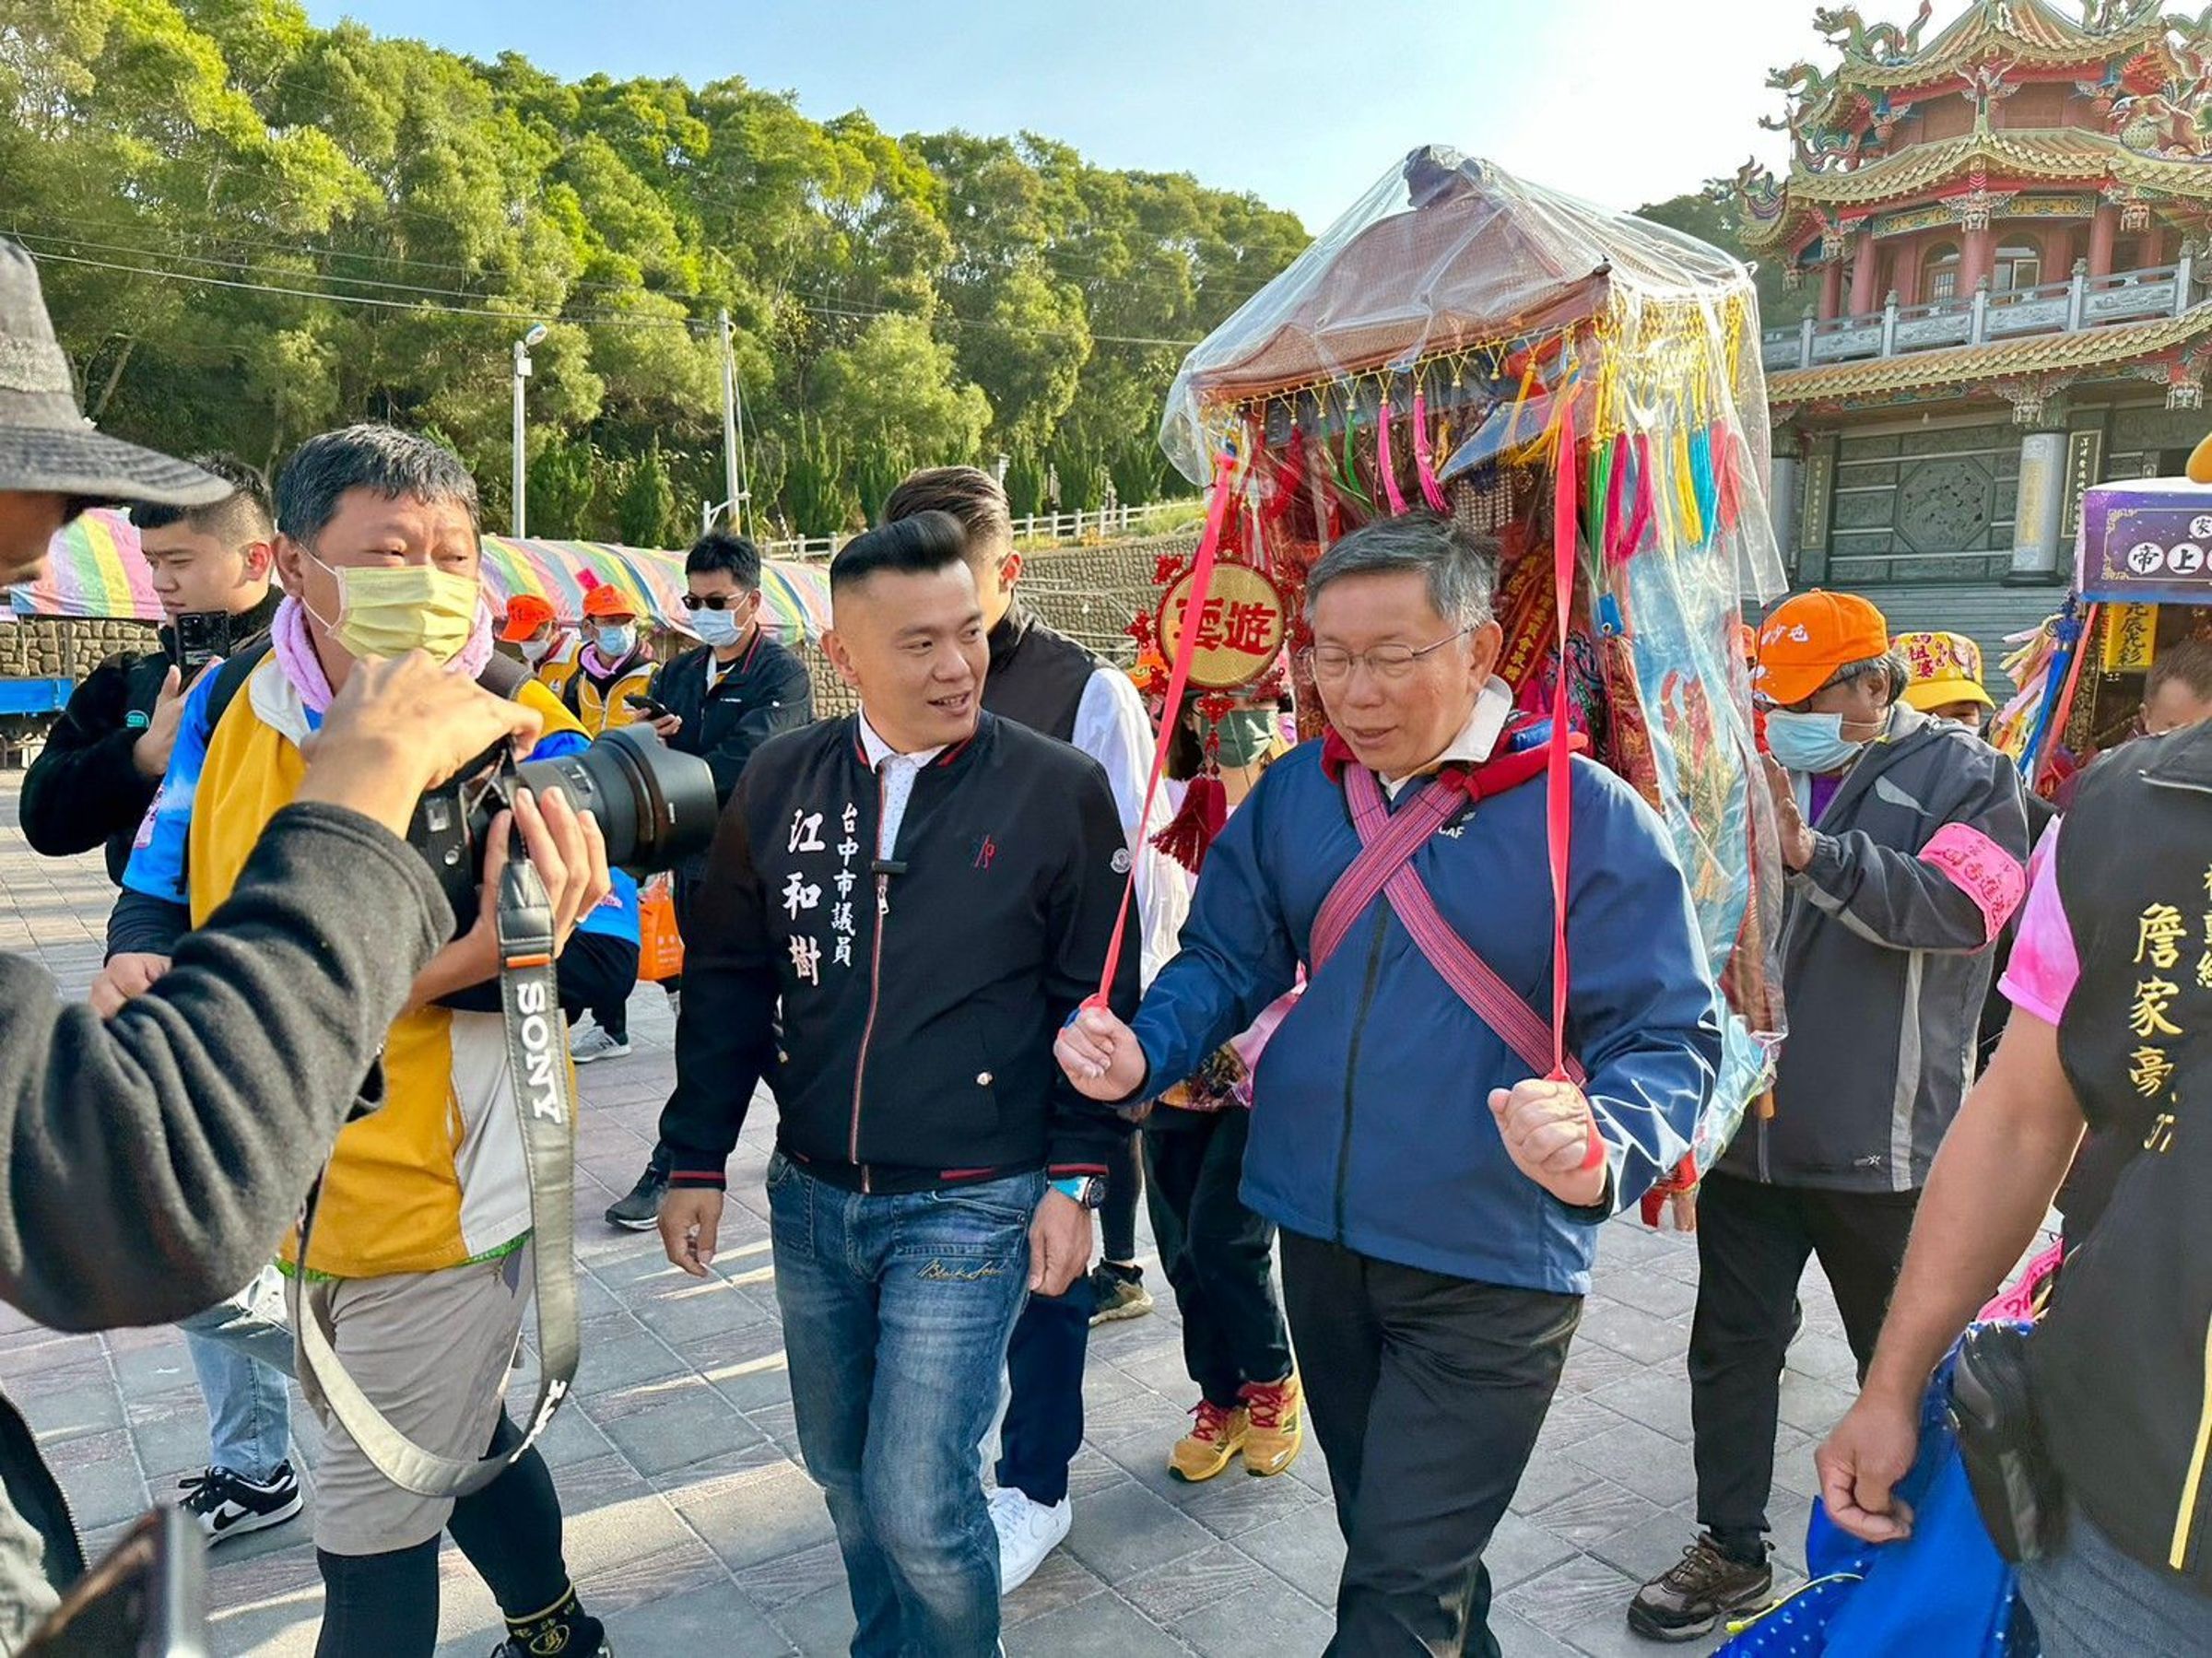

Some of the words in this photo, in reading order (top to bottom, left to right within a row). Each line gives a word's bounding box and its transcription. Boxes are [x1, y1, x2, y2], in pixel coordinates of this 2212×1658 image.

[782, 808, 826, 986] 江和樹
[831, 803, 859, 967] 台中市議員
[517, 981, 561, 1123] SONY
